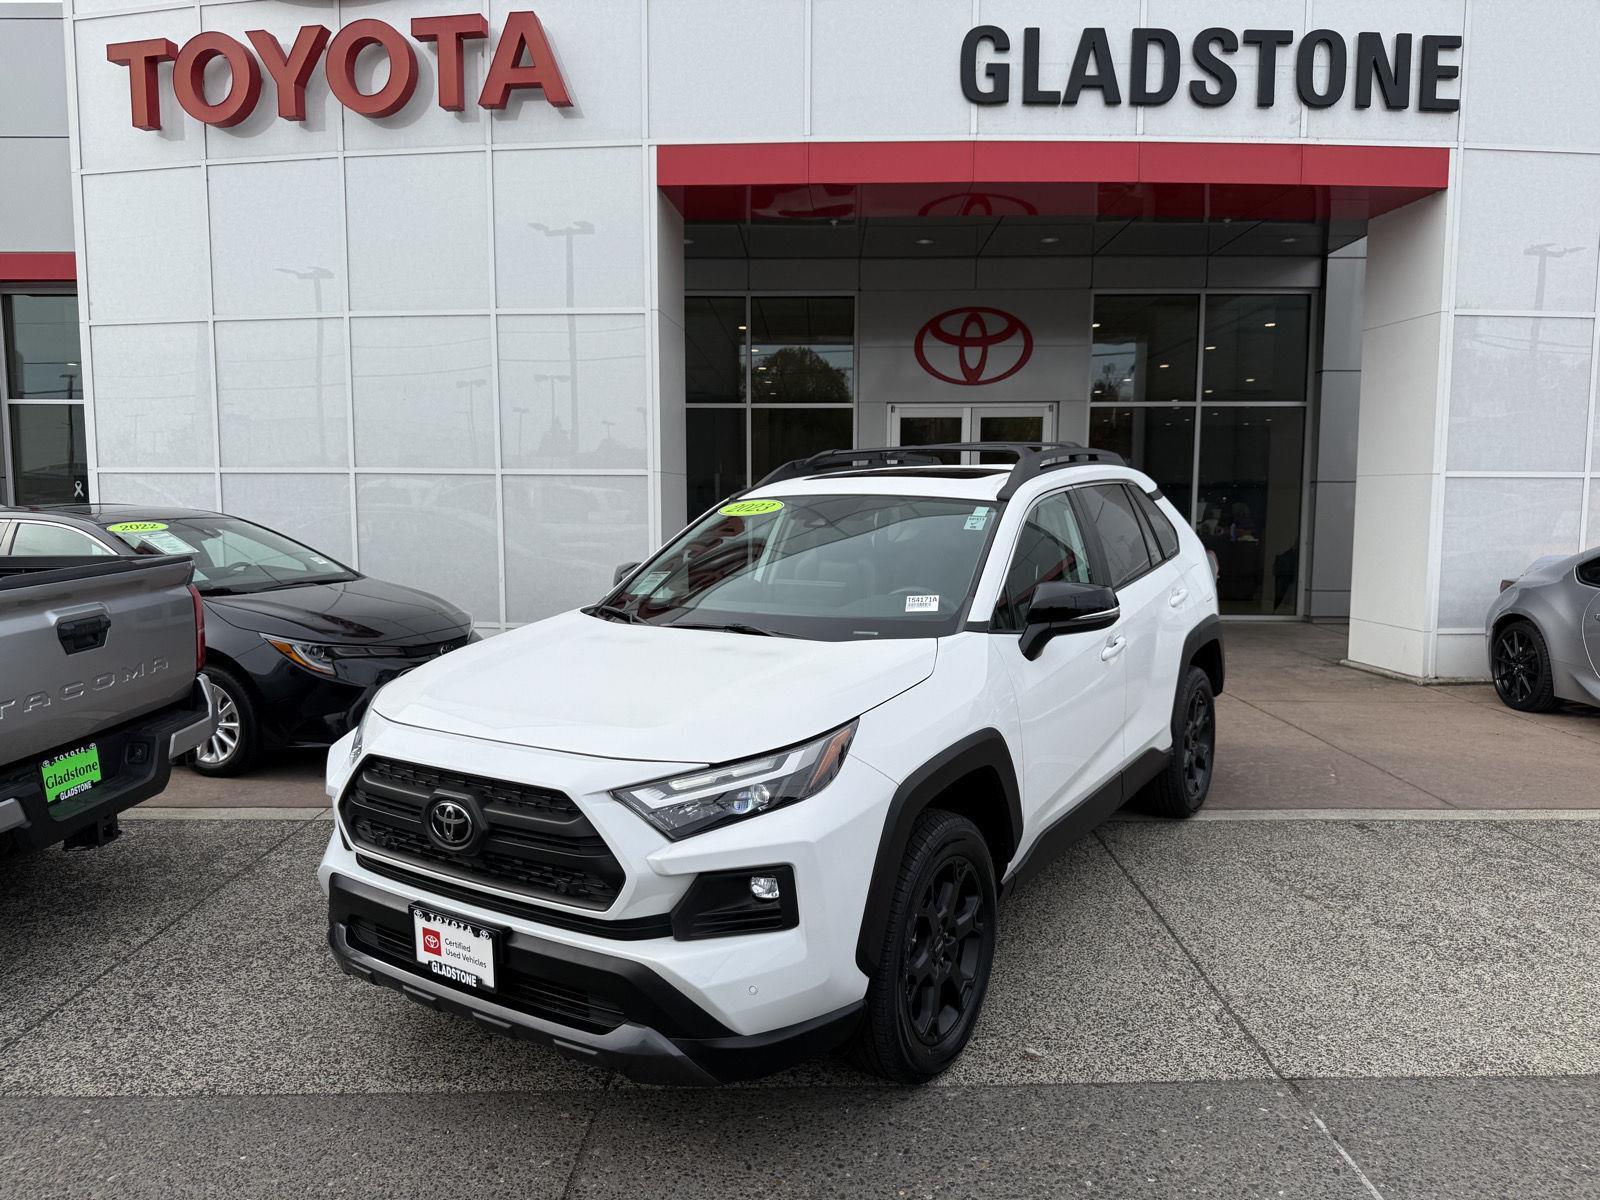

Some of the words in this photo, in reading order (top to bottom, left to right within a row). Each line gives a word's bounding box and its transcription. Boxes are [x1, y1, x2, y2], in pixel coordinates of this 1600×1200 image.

[106, 11, 574, 131] TOYOTA
[960, 25, 1462, 112] GLADSTONE
[119, 523, 159, 532] 2022
[54, 746, 86, 763] TOYOTA
[45, 760, 99, 790] Gladstone
[60, 780, 93, 801] GLADSTONE
[429, 913, 473, 934] TOYOTA
[444, 937, 471, 953] Certified
[445, 948, 461, 960] Used
[461, 953, 487, 969] Vehicles
[431, 961, 477, 988] GLADSTONE
